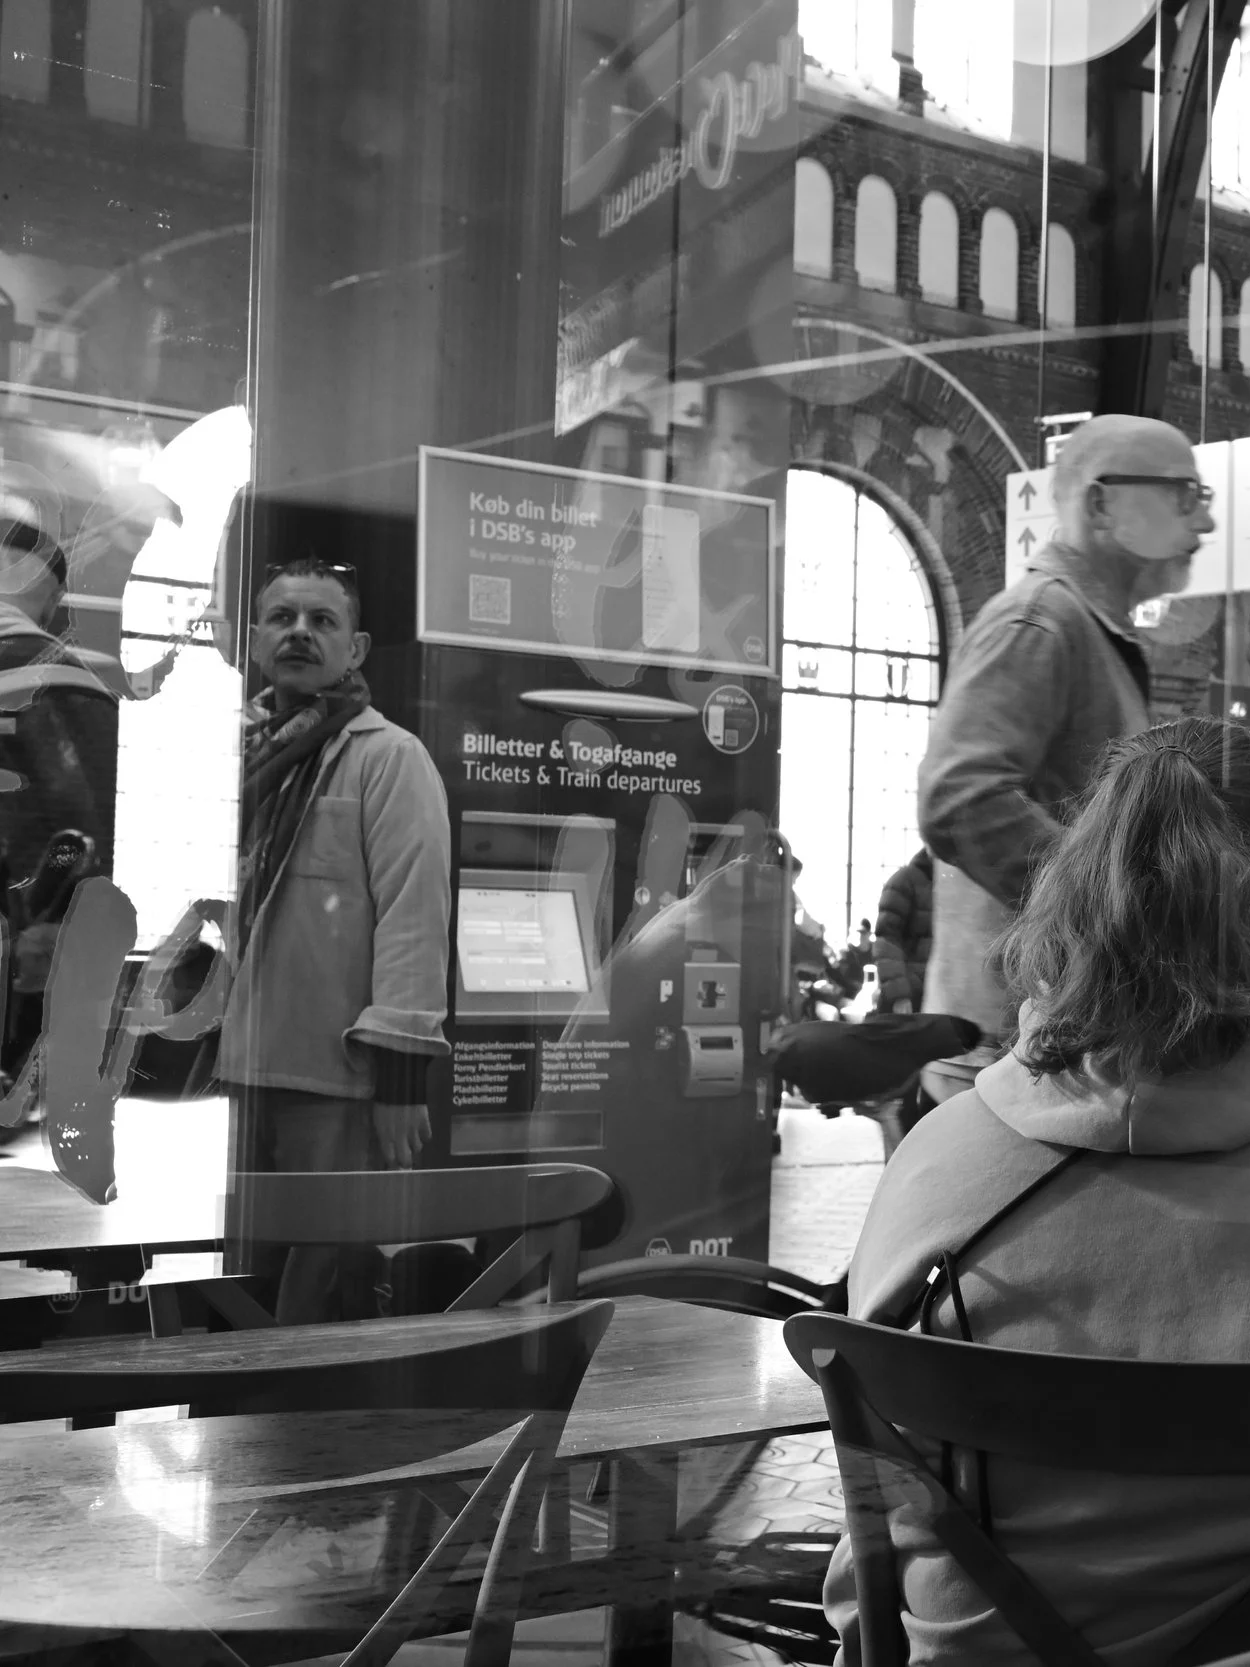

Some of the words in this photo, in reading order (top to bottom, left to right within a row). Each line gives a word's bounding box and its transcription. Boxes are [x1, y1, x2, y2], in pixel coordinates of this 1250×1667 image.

[469, 491, 511, 517] Køb
[515, 497, 545, 520] din
[551, 502, 598, 528] billet
[468, 518, 475, 538] i
[482, 518, 535, 546] DSB's
[540, 531, 577, 554] app
[462, 732, 544, 759] Billetter
[549, 739, 564, 760] &
[568, 740, 678, 771] Togafgange
[462, 759, 531, 785] Tickets
[536, 765, 551, 785] &
[556, 765, 601, 788] Train
[606, 769, 702, 795] departures
[454, 1041, 536, 1052] Afgangsinformation
[542, 1040, 583, 1051] Departure
[583, 1039, 630, 1050] information
[583, 1050, 610, 1060] tickets
[570, 1061, 597, 1070] tickets
[453, 1074, 509, 1083] Turistbilletter
[560, 1071, 609, 1081] reservations
[453, 1085, 508, 1094] Pladsbilletter
[541, 1082, 569, 1093] Bicycle
[570, 1081, 601, 1092] permits
[452, 1095, 508, 1106] Cykelbilletter
[108, 1280, 147, 1305] DO
